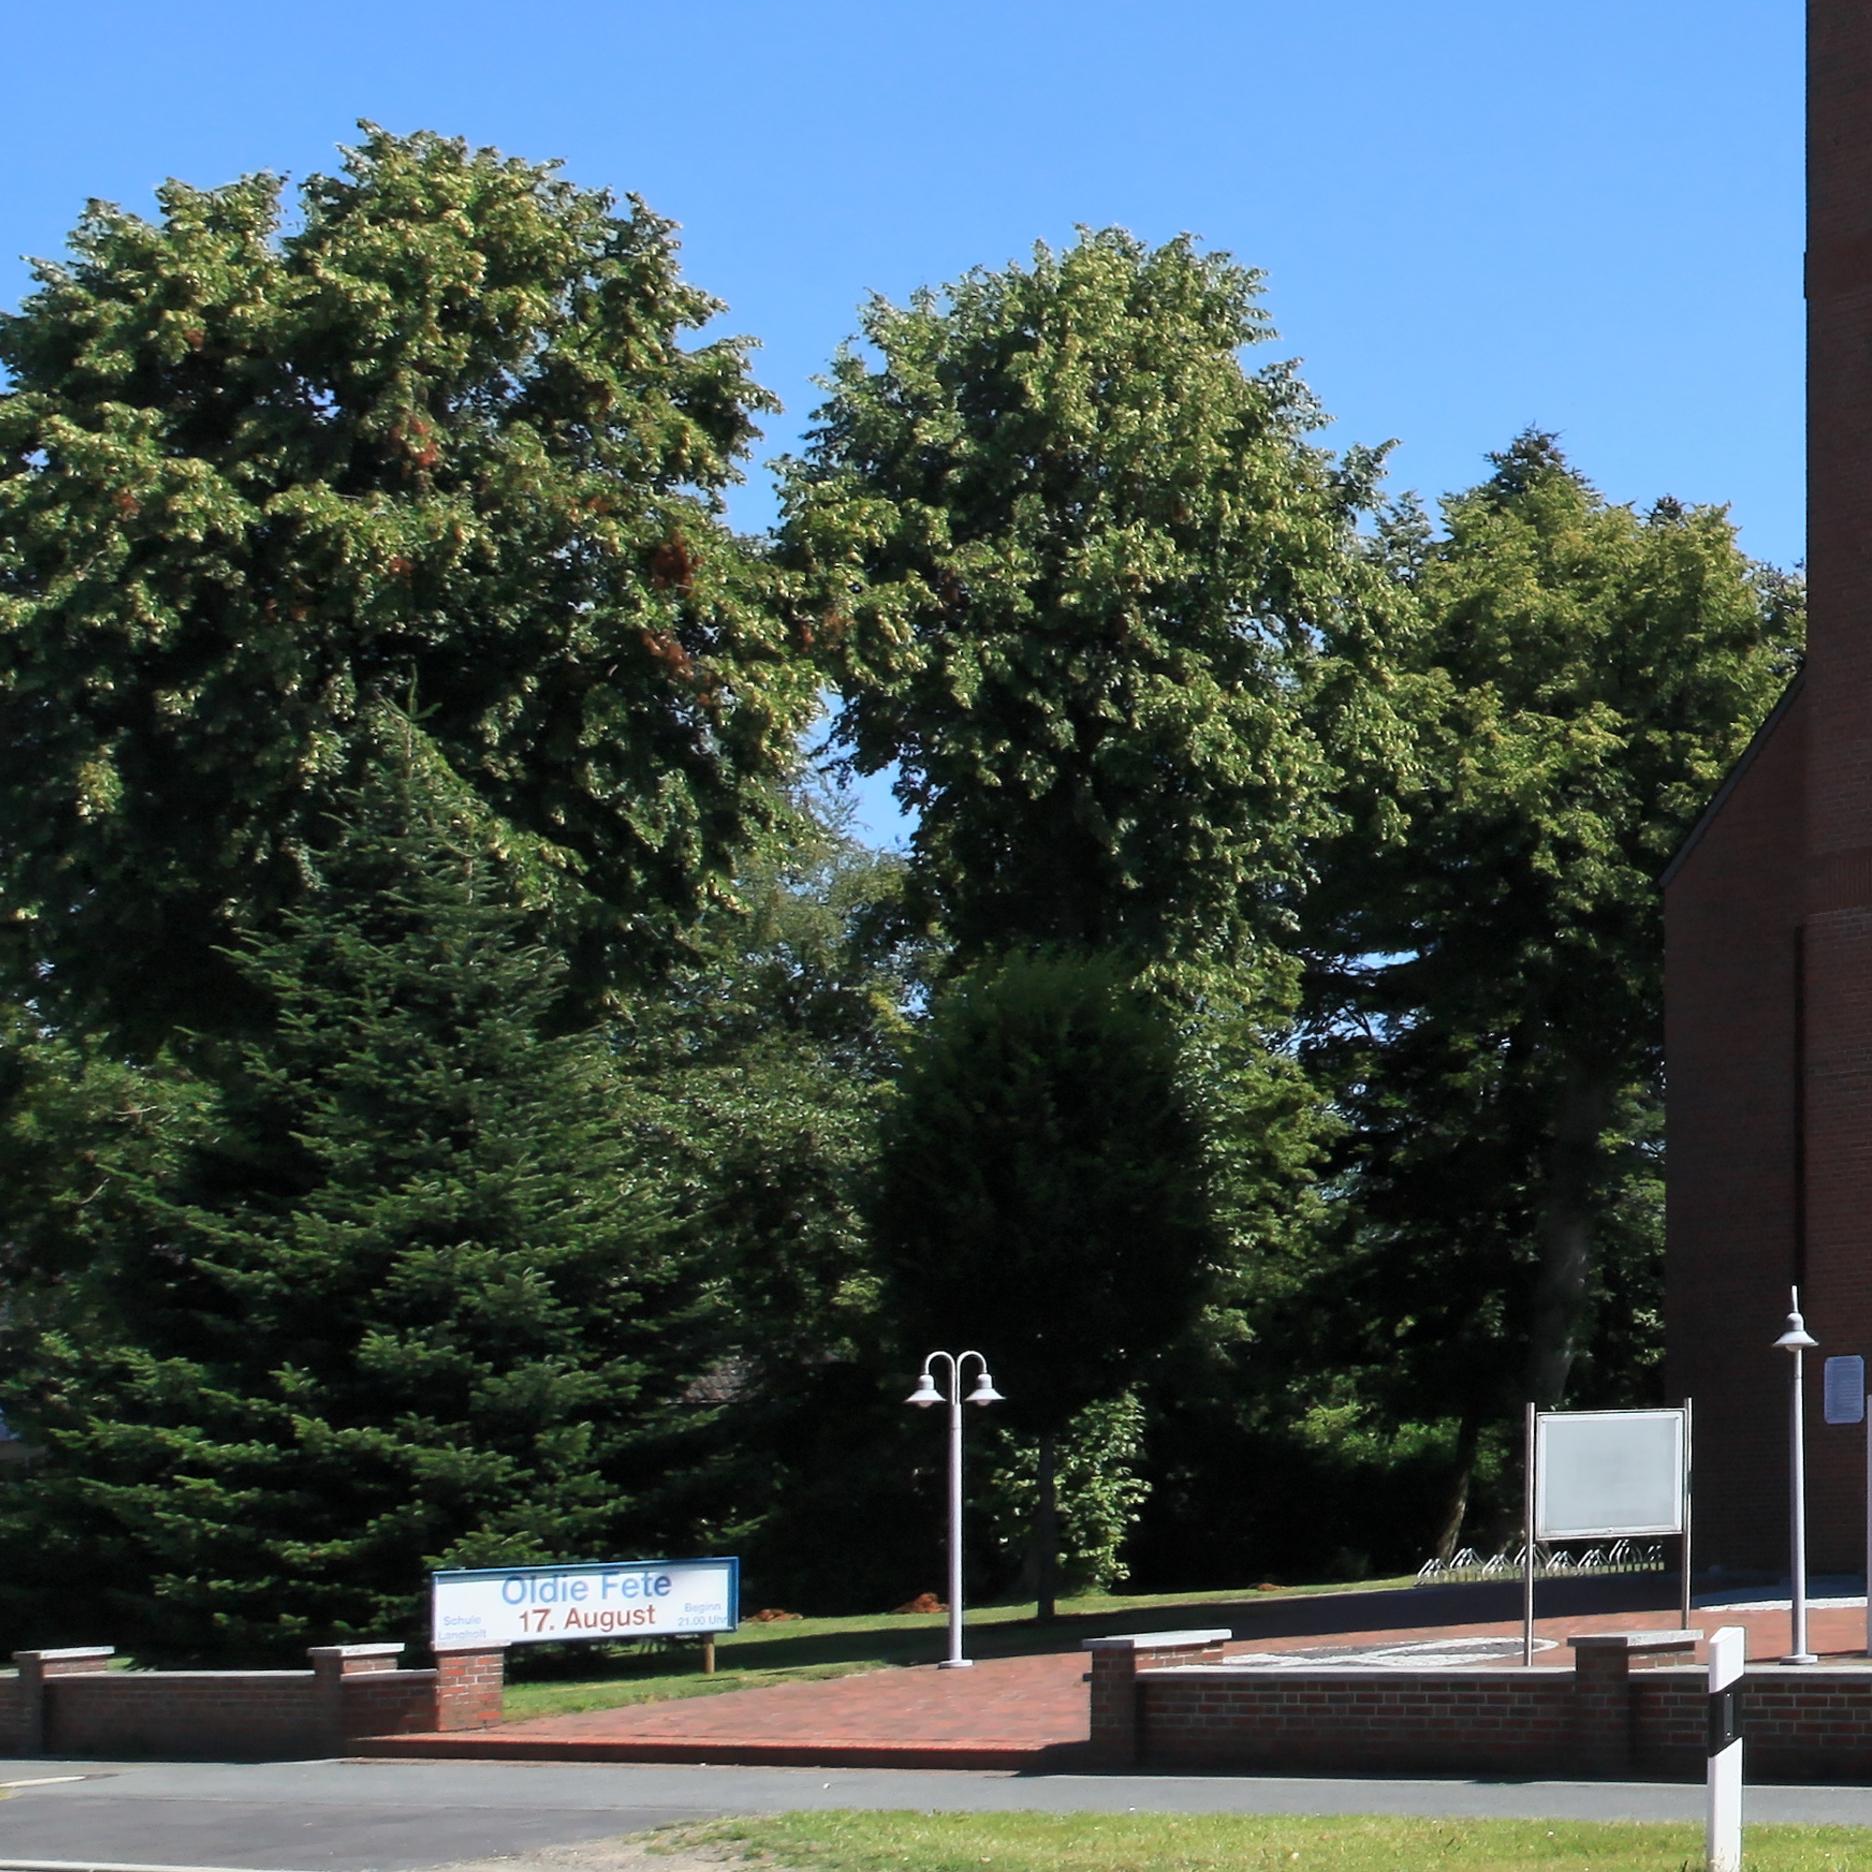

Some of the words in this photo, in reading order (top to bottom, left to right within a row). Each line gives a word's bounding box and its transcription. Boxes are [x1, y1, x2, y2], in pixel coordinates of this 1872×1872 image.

[502, 1574, 589, 1605] Oldie
[602, 1571, 672, 1599] Fete
[518, 1608, 555, 1633] 17.
[565, 1604, 656, 1633] August
[684, 1603, 721, 1614] Beginn
[709, 1615, 728, 1625] Uhr
